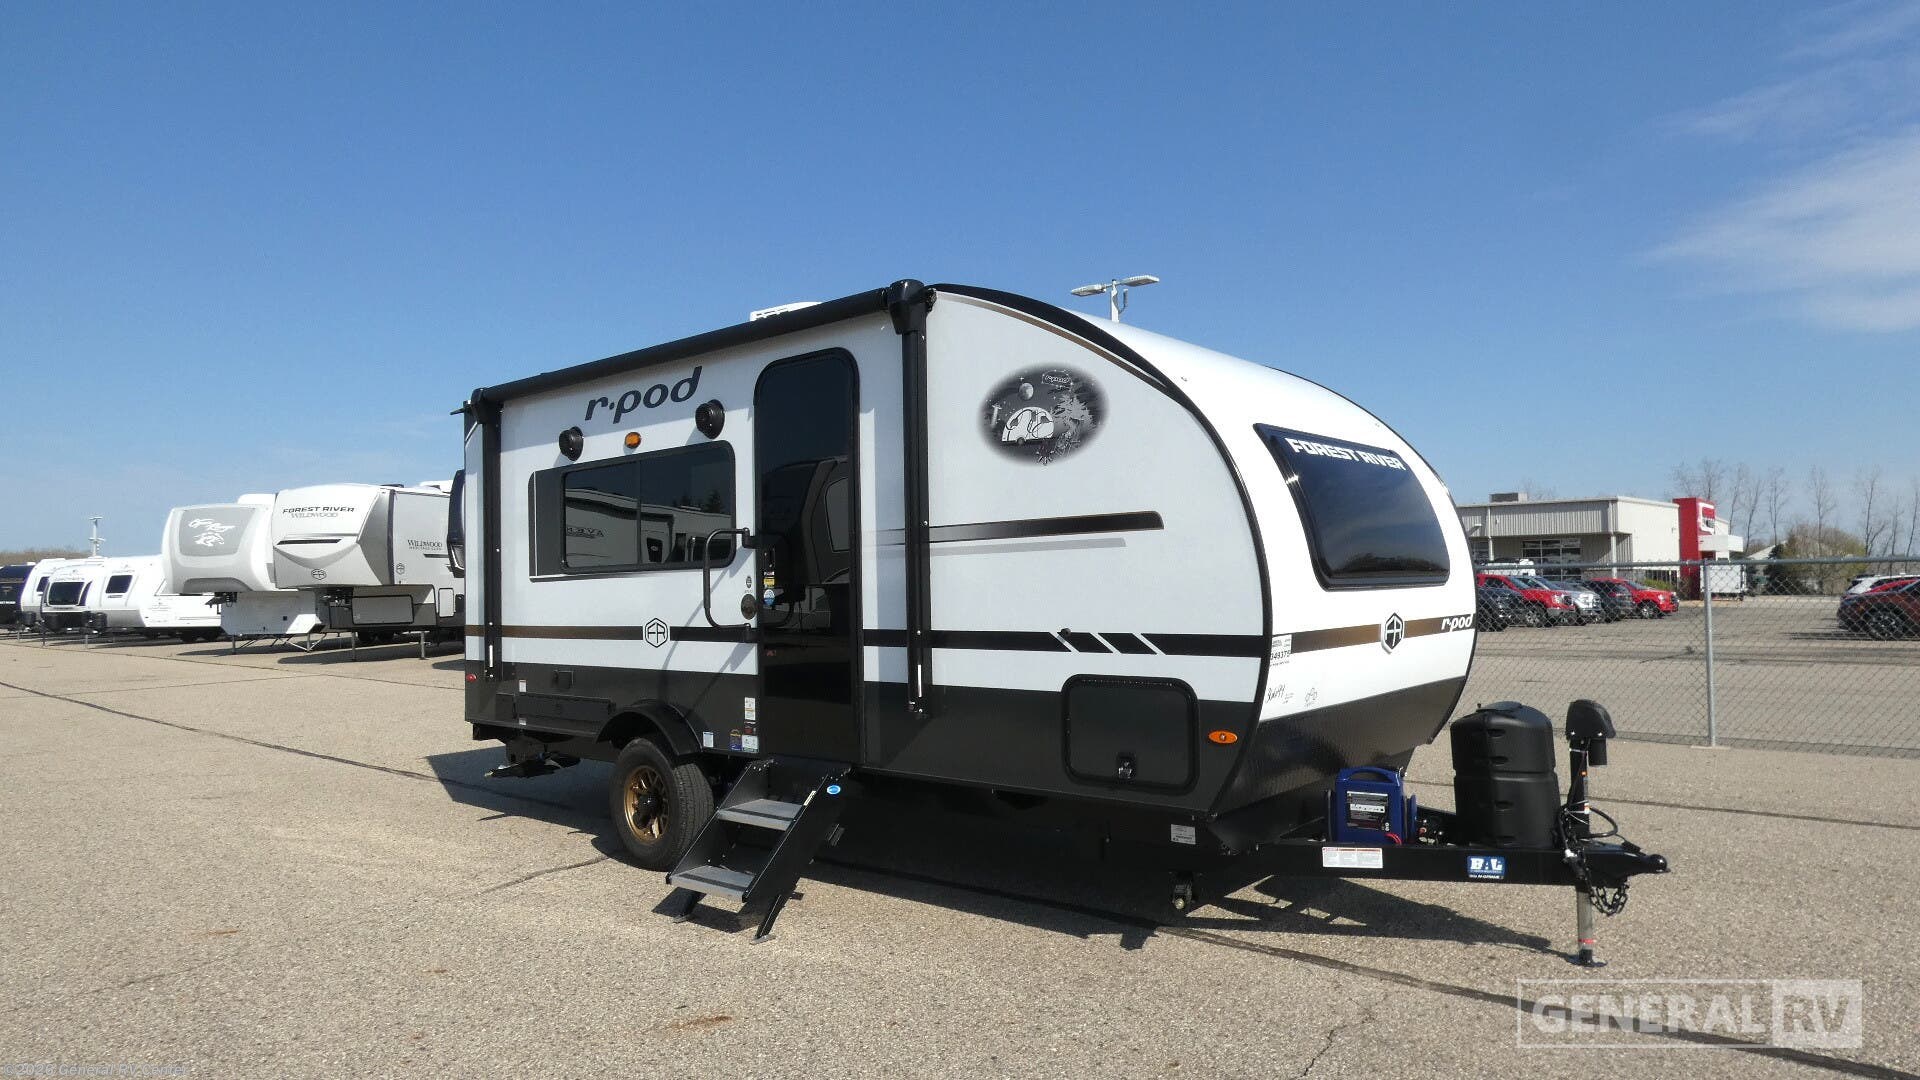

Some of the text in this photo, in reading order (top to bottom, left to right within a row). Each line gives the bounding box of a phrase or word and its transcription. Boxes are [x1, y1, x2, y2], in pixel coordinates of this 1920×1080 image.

[1284, 437, 1406, 471] FOREST RIVER
[283, 506, 320, 514] FOREST
